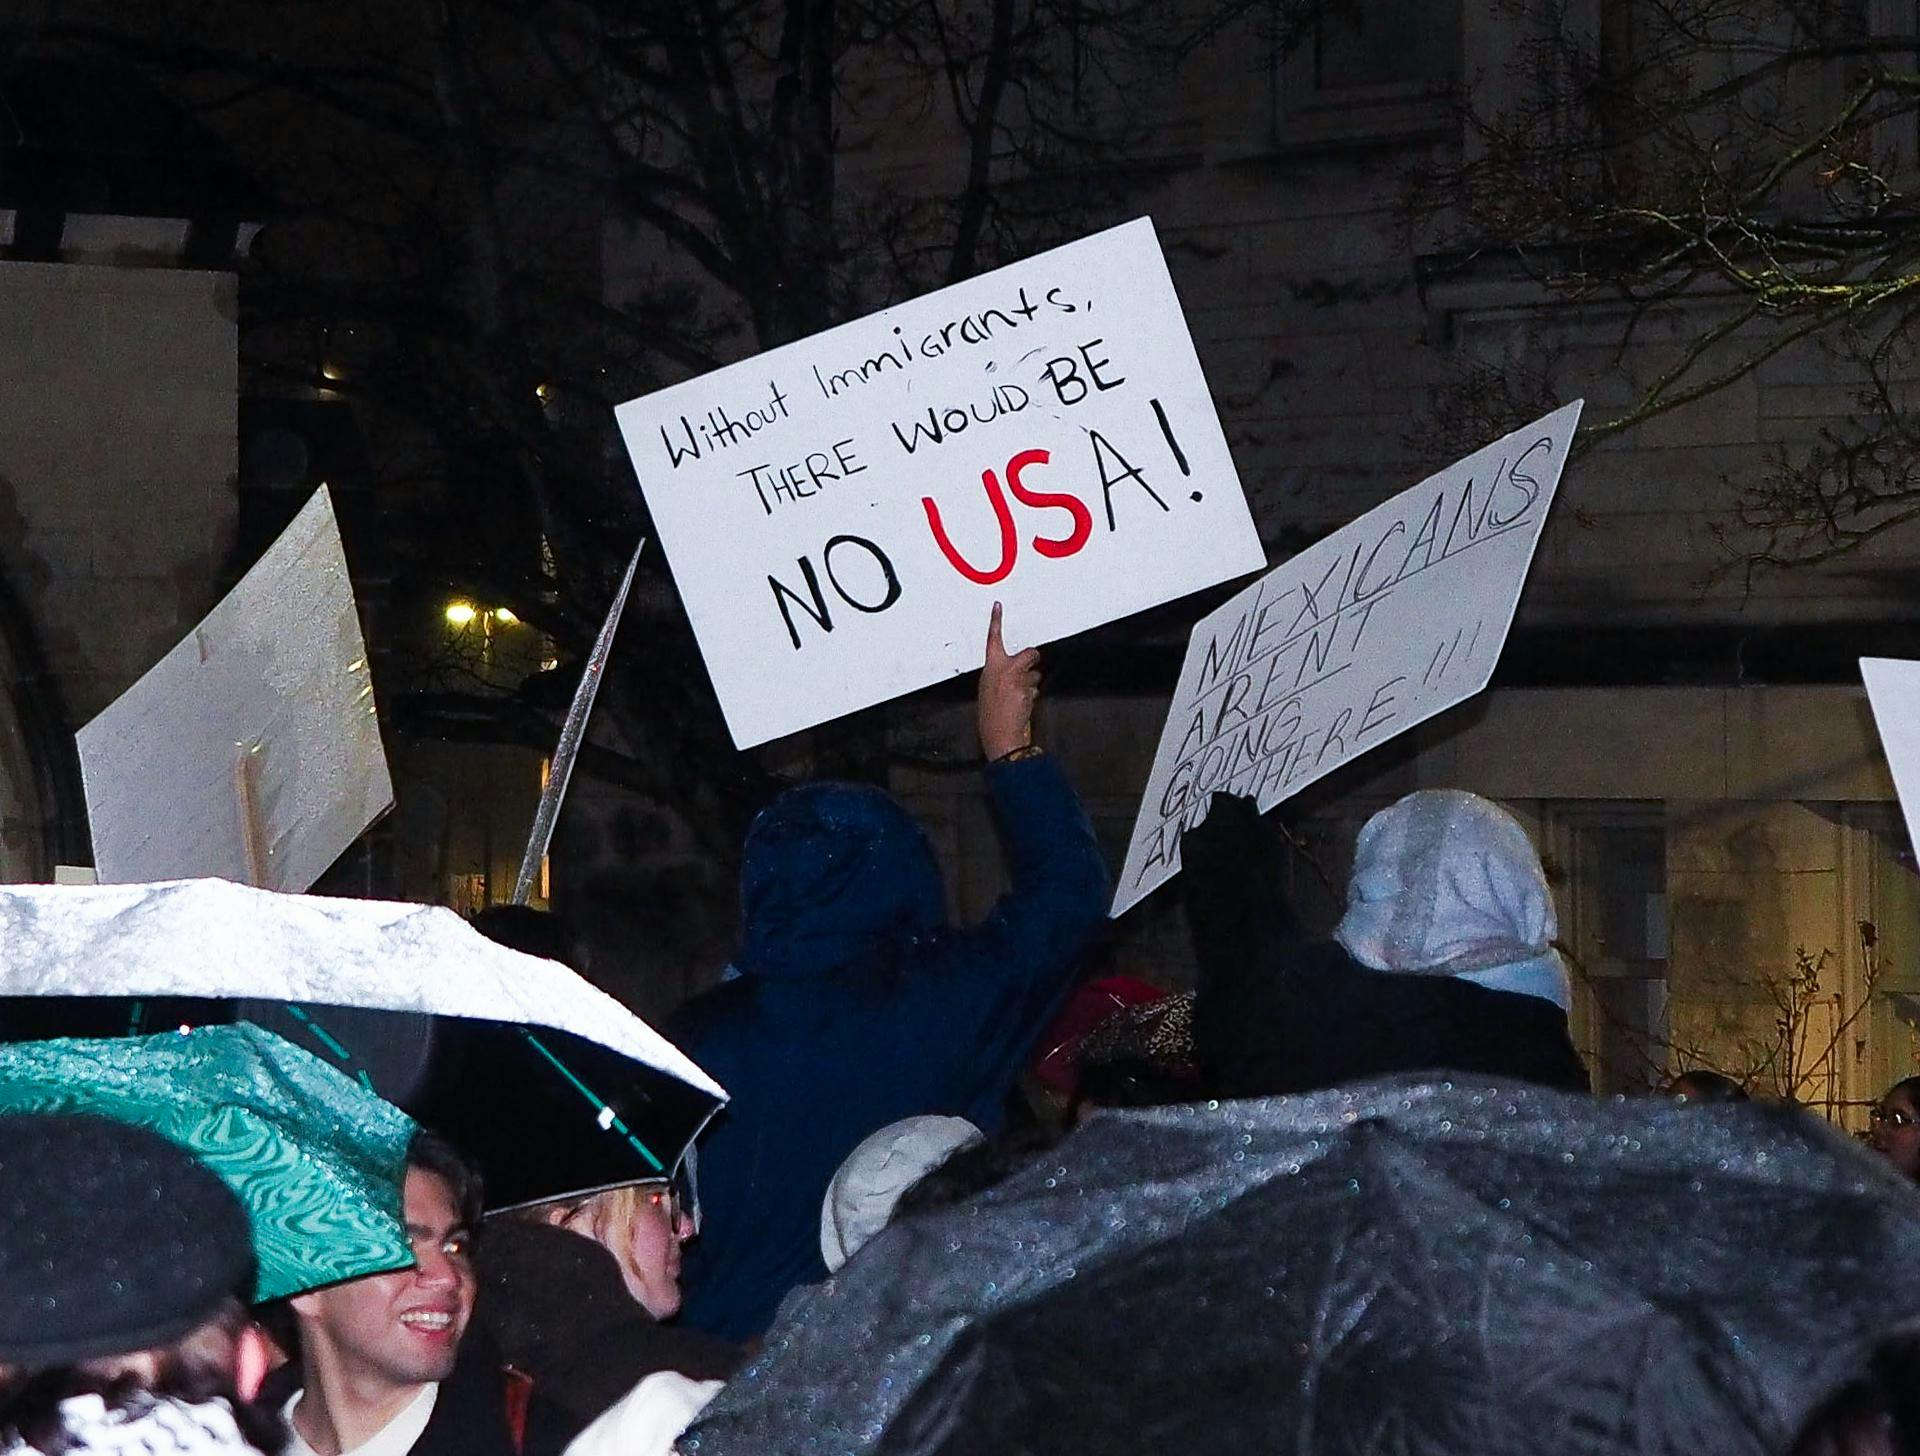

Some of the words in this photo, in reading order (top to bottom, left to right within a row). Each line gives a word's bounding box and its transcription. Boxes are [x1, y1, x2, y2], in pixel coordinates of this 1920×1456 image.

[661, 380, 788, 468] Without
[736, 438, 868, 515] THERE
[891, 384, 1029, 453] WOULD
[1042, 338, 1126, 406] BE
[767, 534, 902, 650] NO
[921, 398, 1204, 586] USA!
[1196, 437, 1553, 696] MEXICANS
[1160, 696, 1303, 818] GOING
